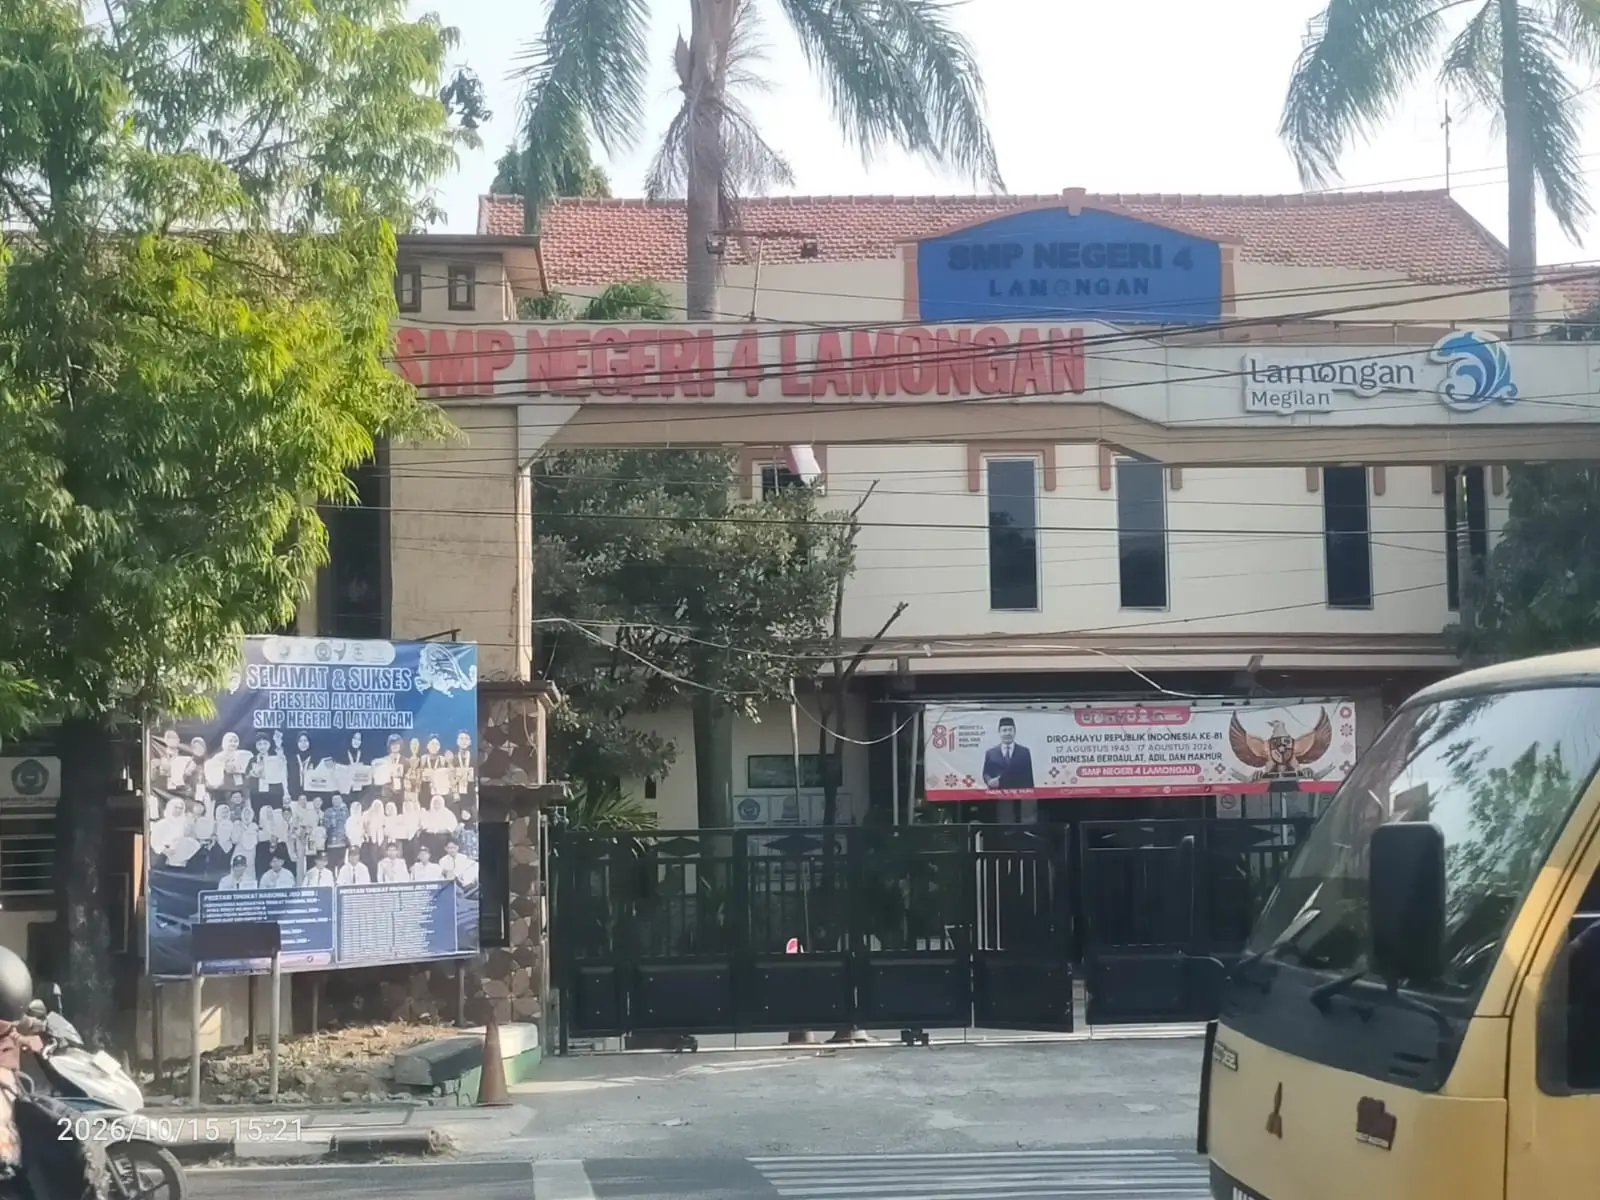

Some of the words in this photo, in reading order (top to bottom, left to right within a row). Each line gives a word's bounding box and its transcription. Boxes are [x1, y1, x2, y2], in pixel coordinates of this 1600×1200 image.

[947, 243, 1023, 271] SMP
[1034, 242, 1162, 270] NEGERI
[1172, 246, 1193, 271] 4
[396, 327, 515, 396] SMP
[526, 328, 716, 398] NEGERI
[728, 329, 762, 396] 4
[778, 326, 1085, 397] LAMONGAN
[1250, 358, 1414, 389] Lamongan
[1251, 390, 1330, 408] Megilan
[246, 664, 328, 691] SELAMAT
[332, 668, 346, 691] &
[350, 667, 412, 692] SUKSES
[269, 691, 329, 709] PRESTASI
[331, 692, 395, 710] AKADEMIK
[253, 709, 285, 729] SMP
[287, 710, 331, 729] NEGERI
[333, 711, 344, 729] 4
[345, 711, 413, 729] LAMONGAN
[932, 724, 957, 752] 81
[1046, 733, 1101, 743] DIRGAHAYU
[1104, 732, 1145, 742] REPUBLIK
[1147, 732, 1197, 742] INDONESIA
[1066, 745, 1109, 753] AGUSTUS
[1147, 743, 1190, 752] AGUSTUS
[1051, 755, 1095, 764] INDONESIA
[1148, 754, 1166, 762] ADIL
[1168, 753, 1186, 762] DAN
[1187, 752, 1223, 761] MAKMUR
[1081, 768, 1101, 776] SMP
[1102, 767, 1134, 776] NEGERI
[1143, 766, 1196, 775] LAMONGAN
